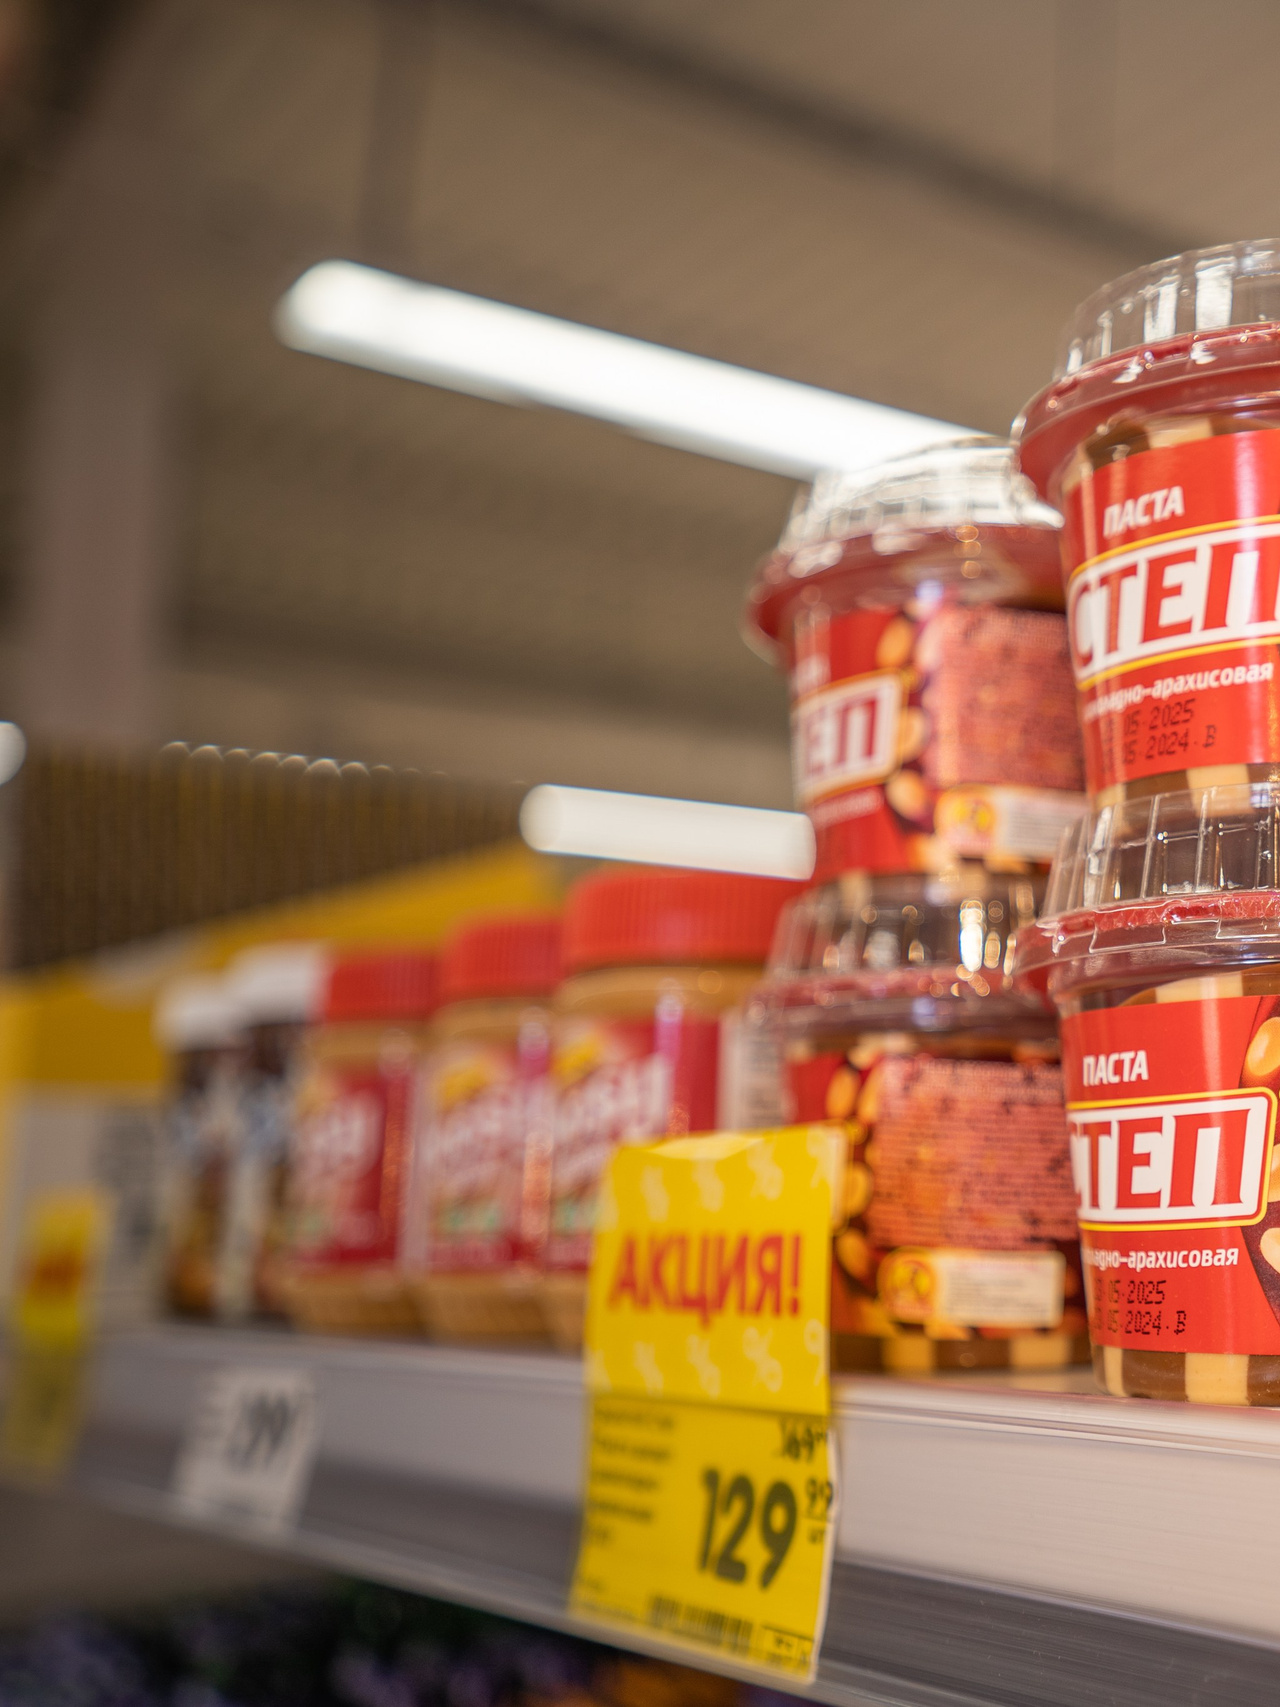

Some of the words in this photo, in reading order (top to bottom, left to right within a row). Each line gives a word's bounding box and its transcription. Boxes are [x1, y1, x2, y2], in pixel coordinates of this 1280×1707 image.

[1103, 486, 1184, 537] ПАСТА
[1084, 1051, 1148, 1086] ПАСТА
[608, 1232, 801, 1331] АКЦИЯ!
[699, 1468, 797, 1592] 129
